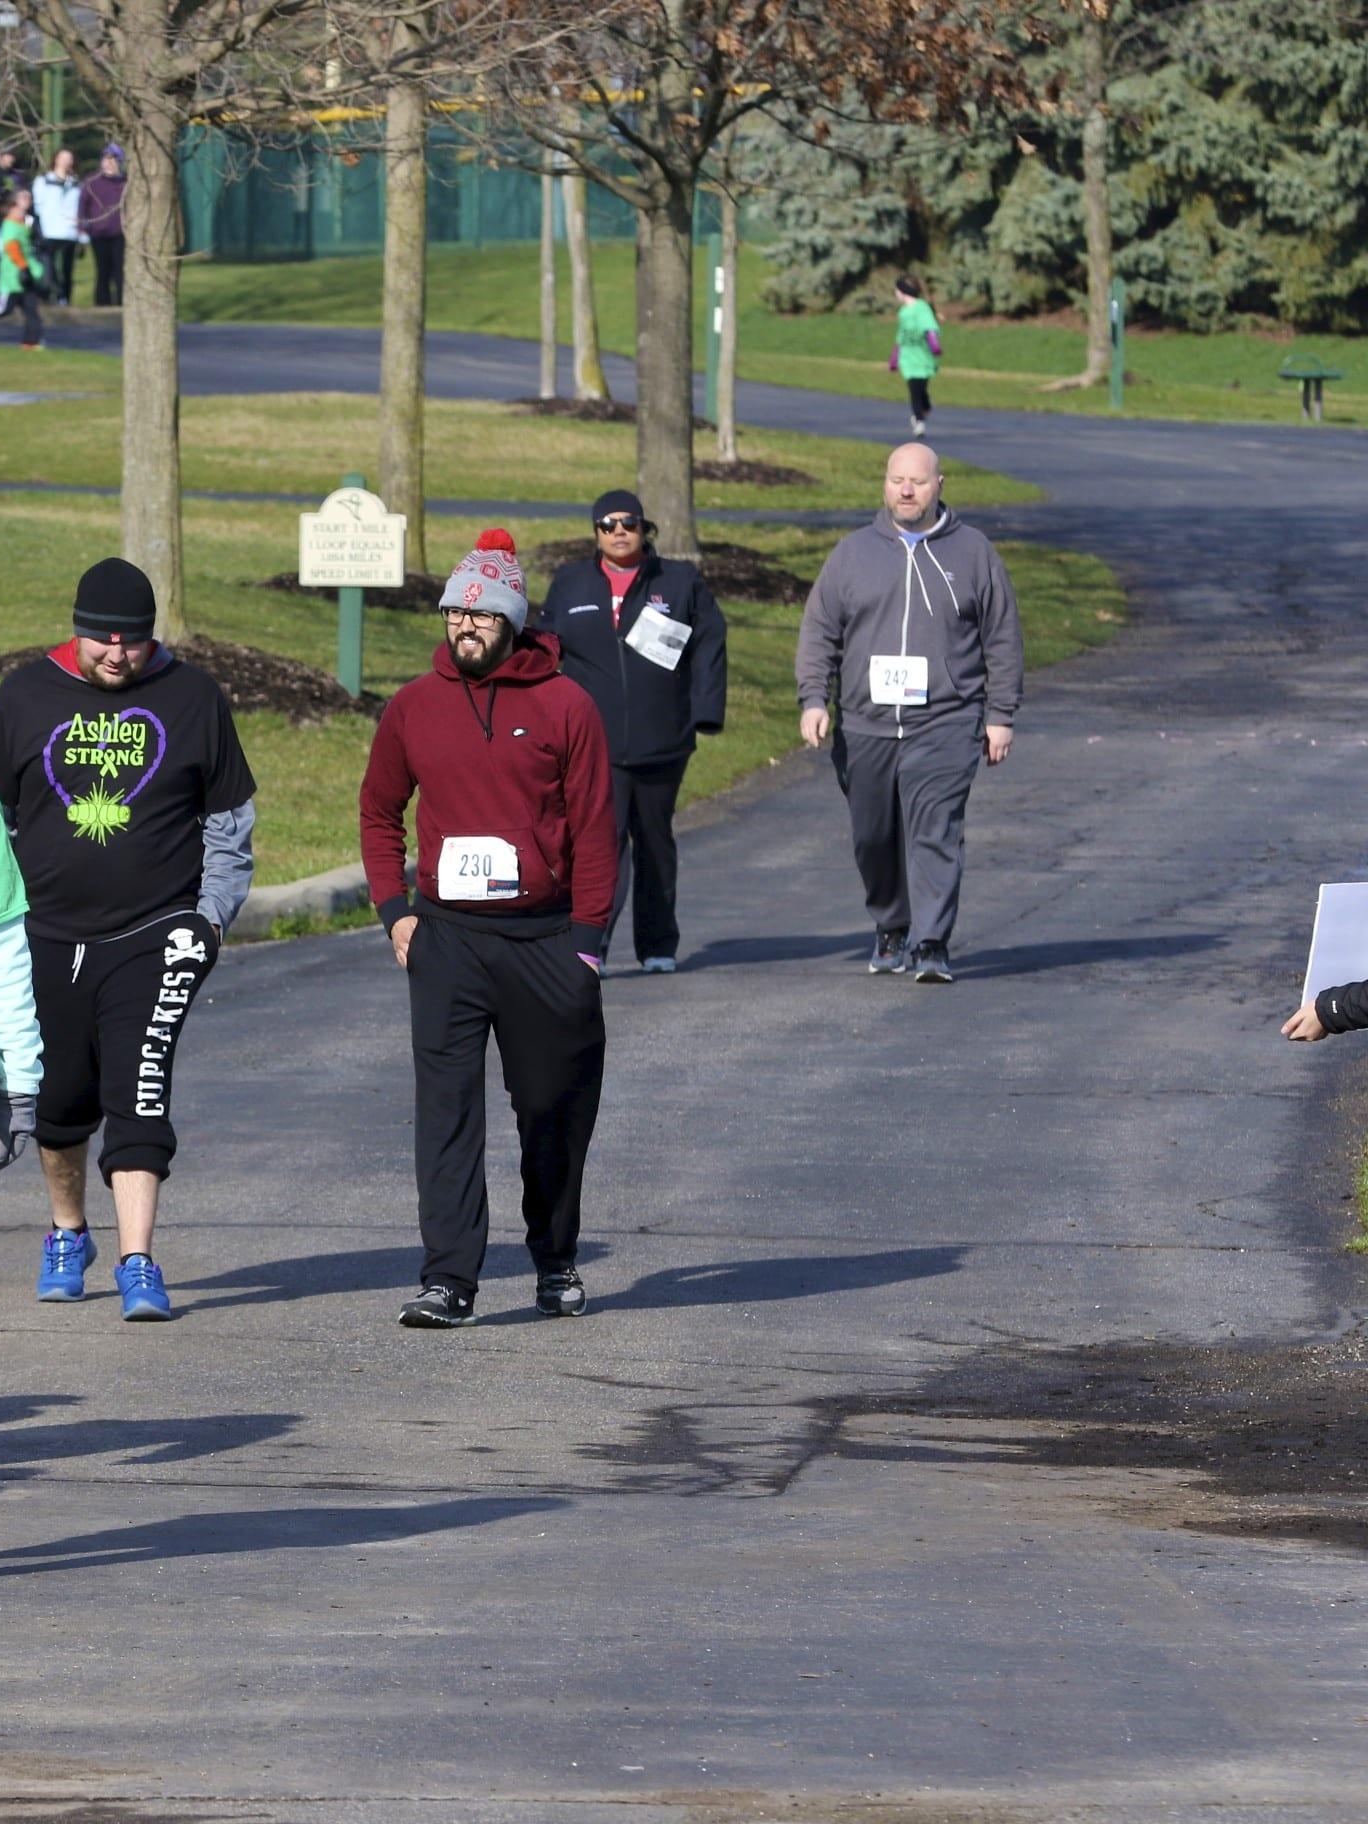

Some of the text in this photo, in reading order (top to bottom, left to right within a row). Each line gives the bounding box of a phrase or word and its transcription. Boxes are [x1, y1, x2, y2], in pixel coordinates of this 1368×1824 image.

[65, 713, 146, 750] Ashley
[64, 747, 145, 768] STRONG
[458, 854, 492, 877] 230
[135, 970, 196, 1118] CUPCAKES
